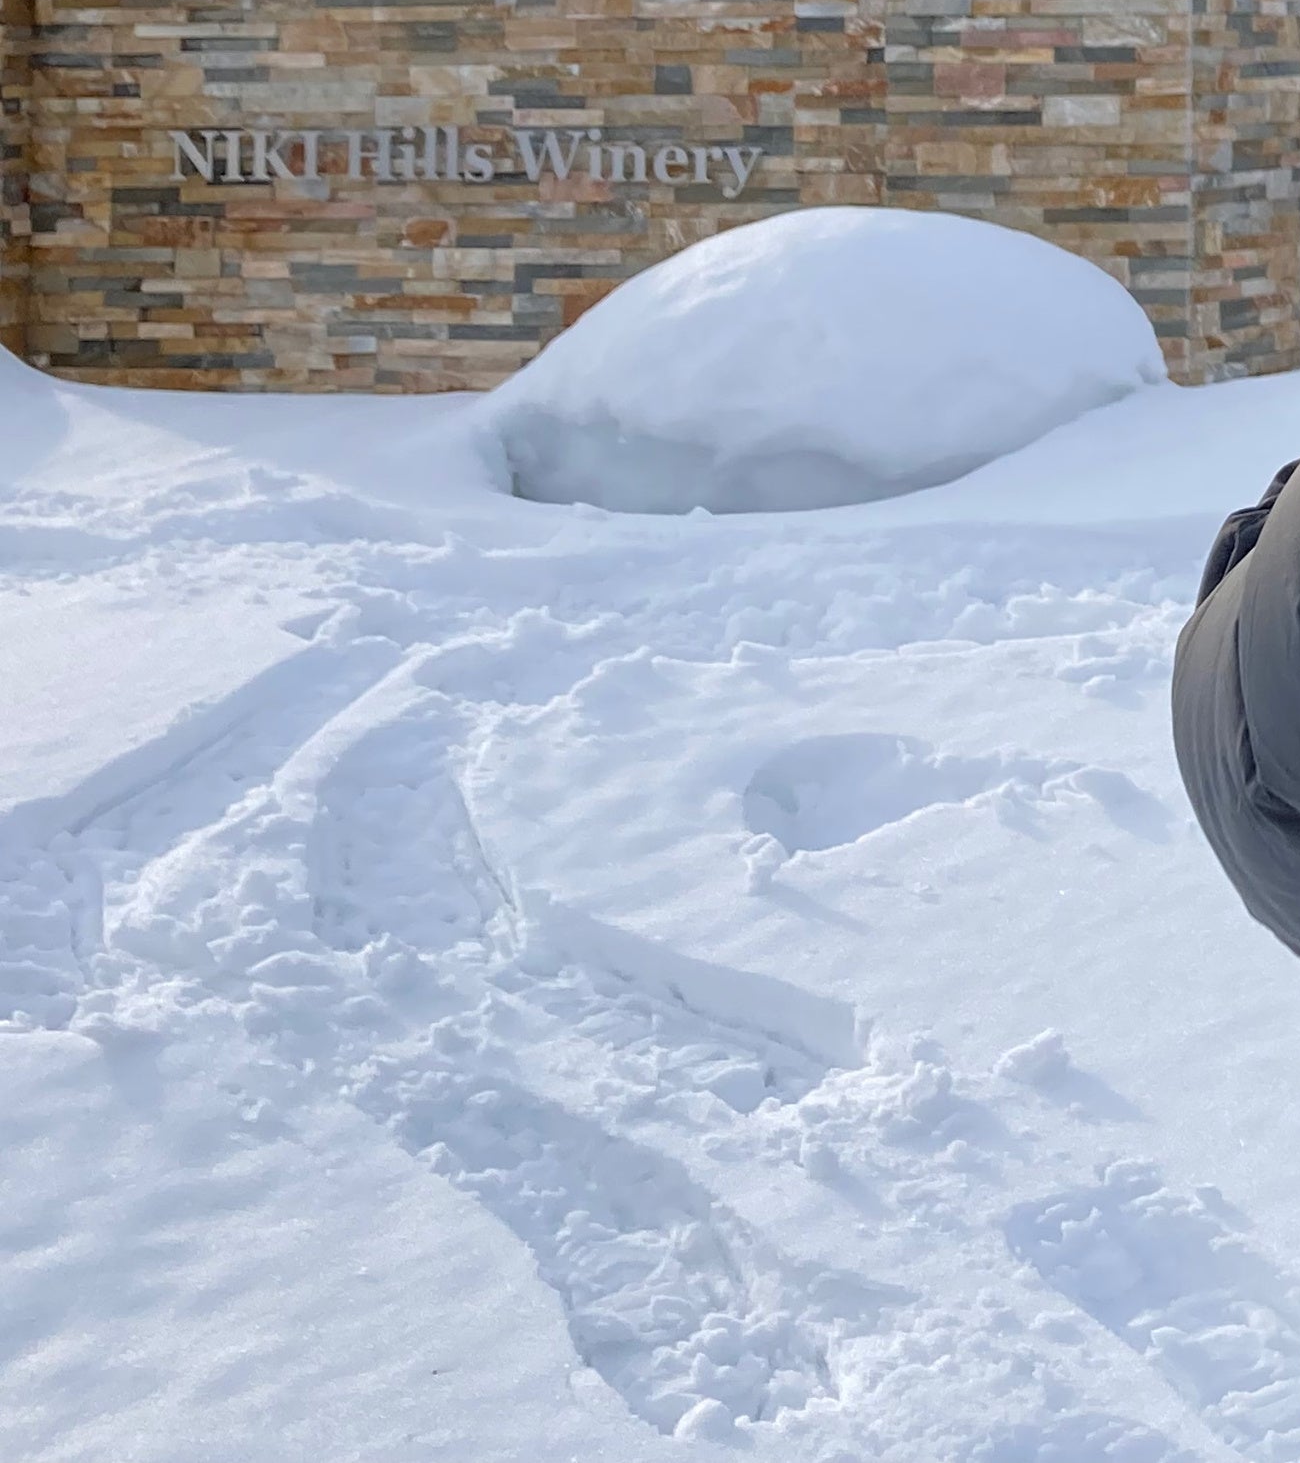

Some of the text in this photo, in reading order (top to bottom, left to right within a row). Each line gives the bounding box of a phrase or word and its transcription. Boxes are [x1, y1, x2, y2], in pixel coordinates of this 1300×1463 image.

[168, 126, 763, 199] NIKI Hills Winery
